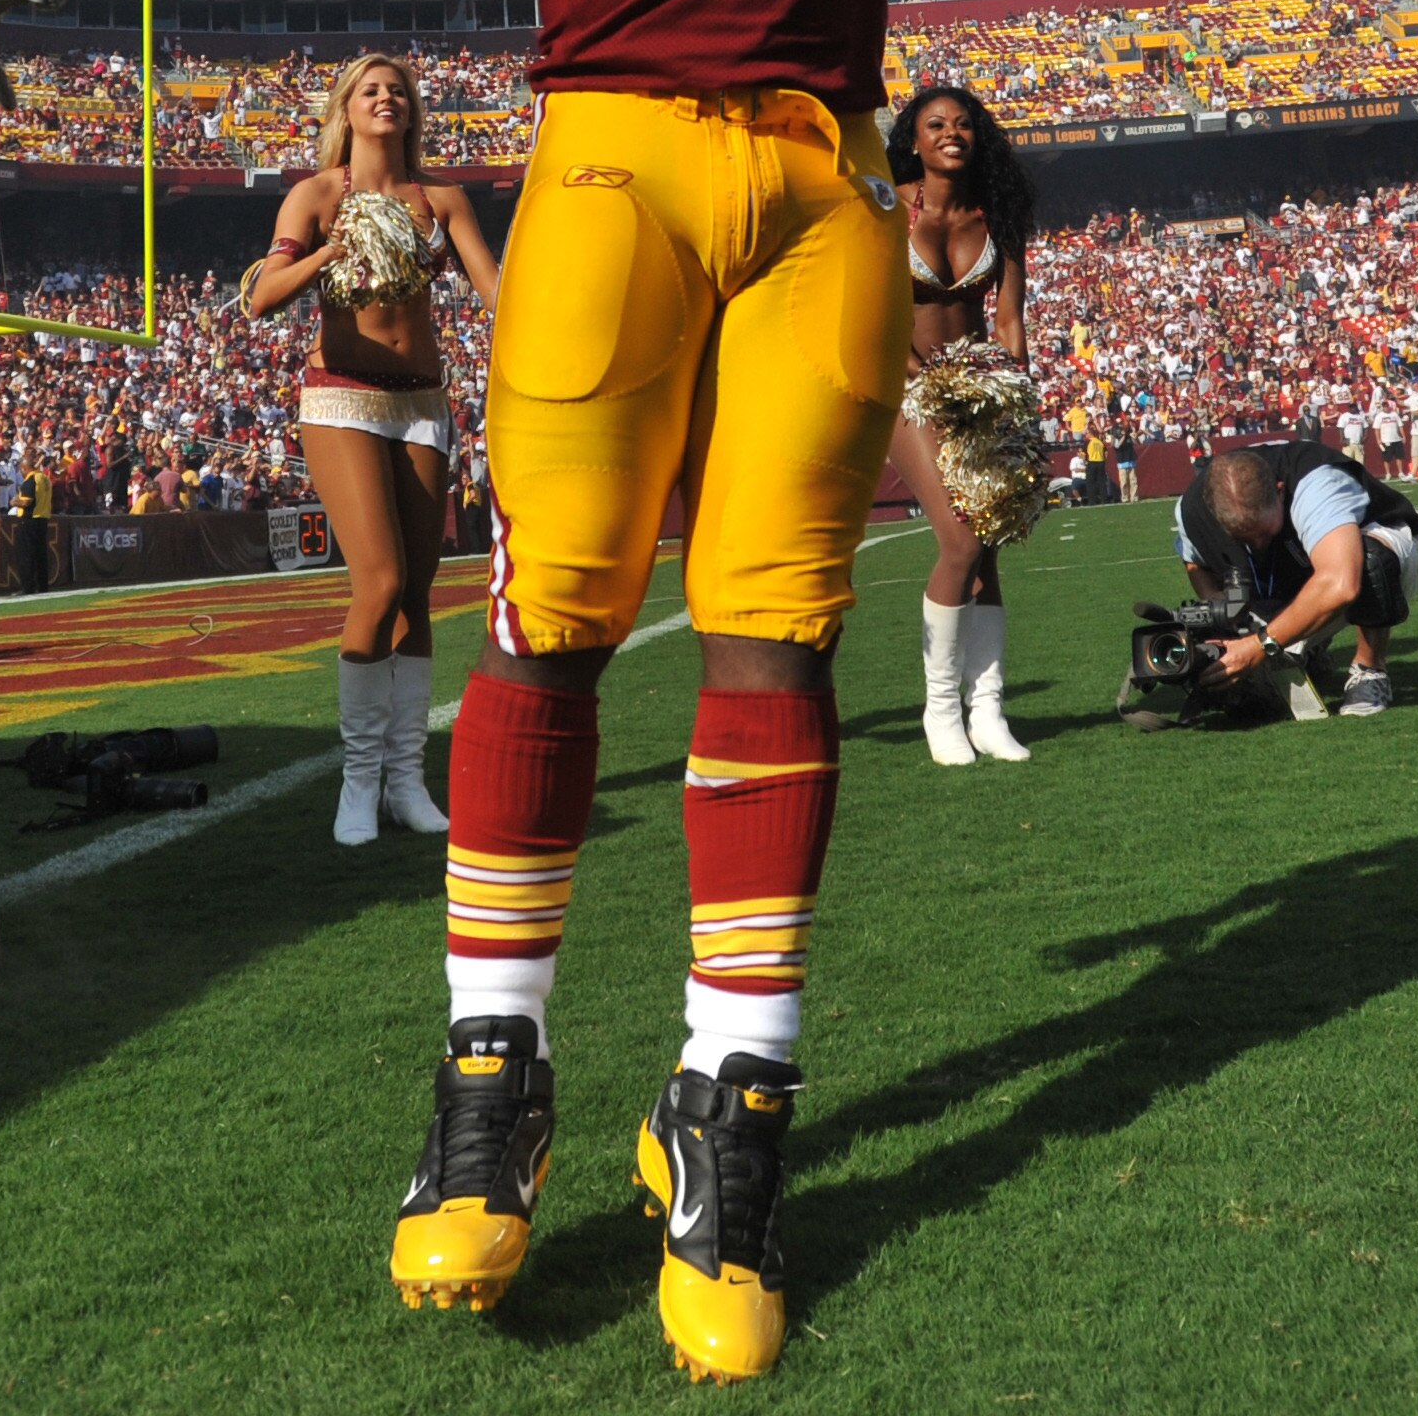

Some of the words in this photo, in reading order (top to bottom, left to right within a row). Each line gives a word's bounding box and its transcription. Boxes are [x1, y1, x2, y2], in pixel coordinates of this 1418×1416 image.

[1283, 107, 1346, 125] REDSKINS
[1351, 102, 1401, 119] LEGACY
[1016, 134, 1028, 146] of
[1031, 132, 1051, 145] the
[1056, 129, 1096, 145] Legacy
[1125, 123, 1186, 136] VALOTTERY.COM
[80, 534, 104, 550] NFL
[114, 533, 139, 548] CBS
[302, 514, 325, 553] 25
